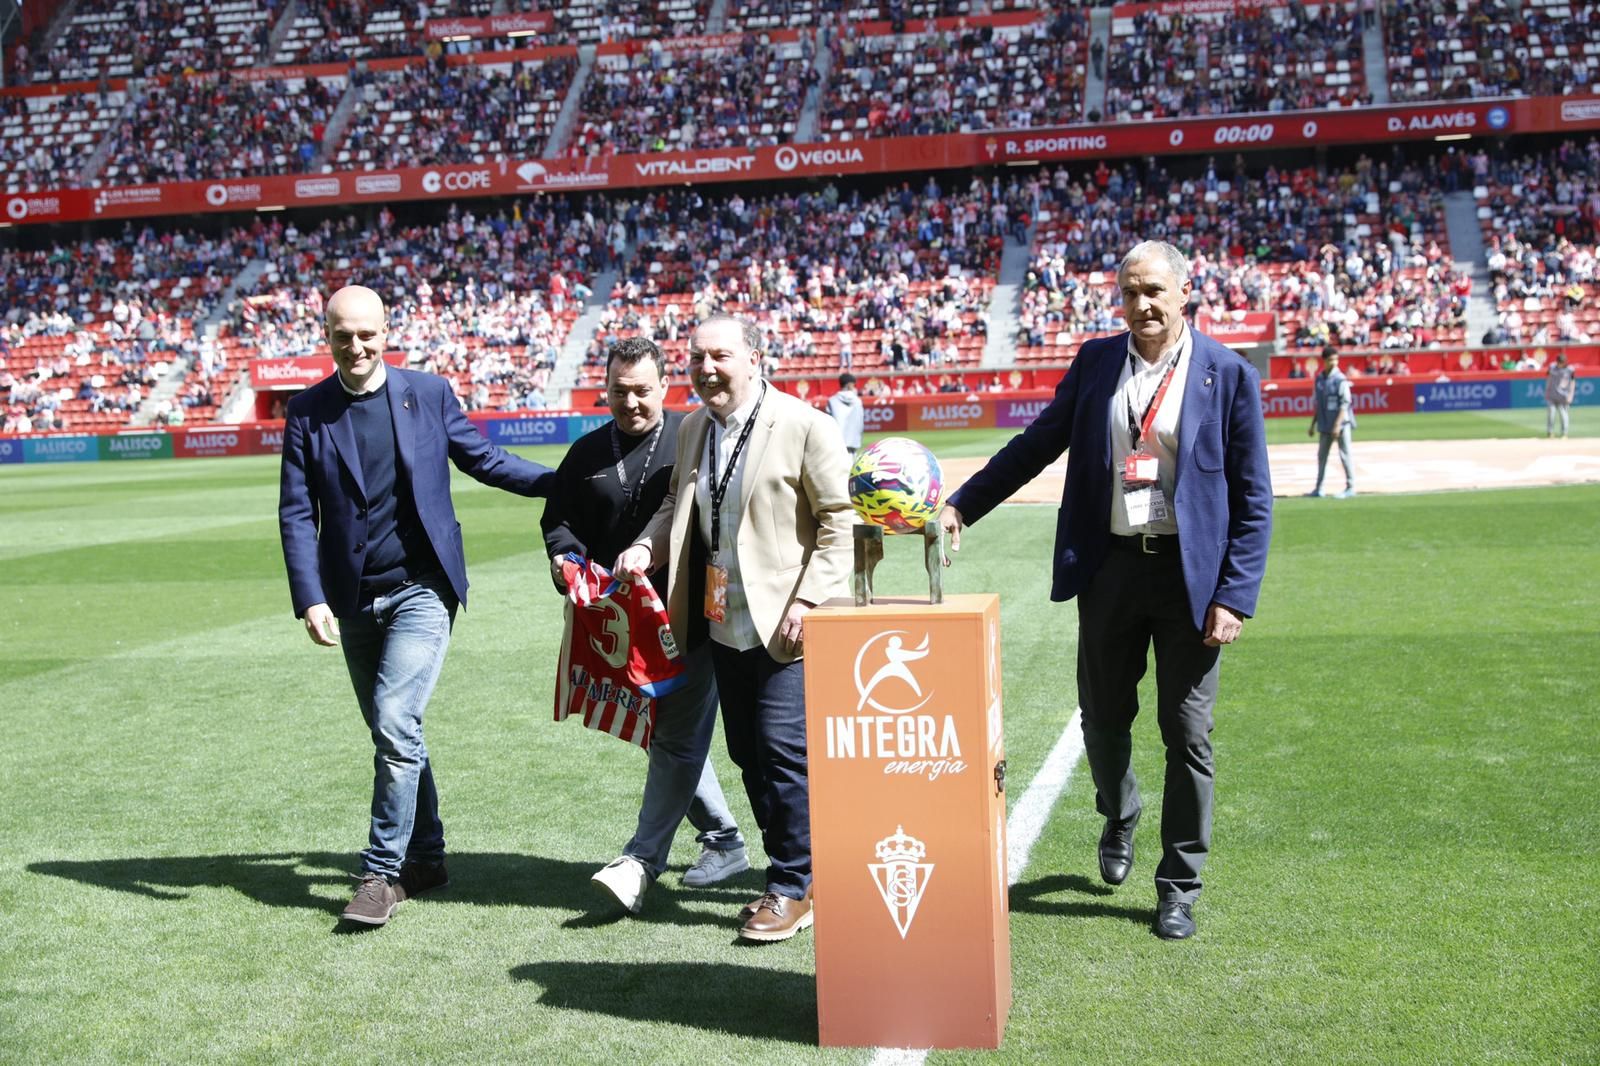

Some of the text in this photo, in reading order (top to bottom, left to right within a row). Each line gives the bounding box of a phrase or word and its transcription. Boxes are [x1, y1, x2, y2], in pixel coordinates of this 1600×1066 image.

[1303, 121, 1317, 138] 0
[1387, 110, 1475, 131] D. ALAVÉS
[1169, 130, 1183, 146] 0
[1213, 124, 1273, 143] 00:00
[1006, 136, 1107, 154] R. SPORTING
[800, 148, 864, 165] VEOLIA
[636, 156, 756, 177] VITALDENT
[444, 170, 491, 190] COPE
[1429, 384, 1497, 402] JALISCO
[921, 403, 983, 421] JALISCO
[499, 420, 557, 437] JALISCO
[34, 440, 87, 455] JALISCO
[109, 437, 162, 452] JALISCO
[184, 433, 239, 449] JALISCO
[588, 597, 630, 669] 3
[825, 714, 962, 759] INTEGRA
[883, 757, 969, 782] energía
